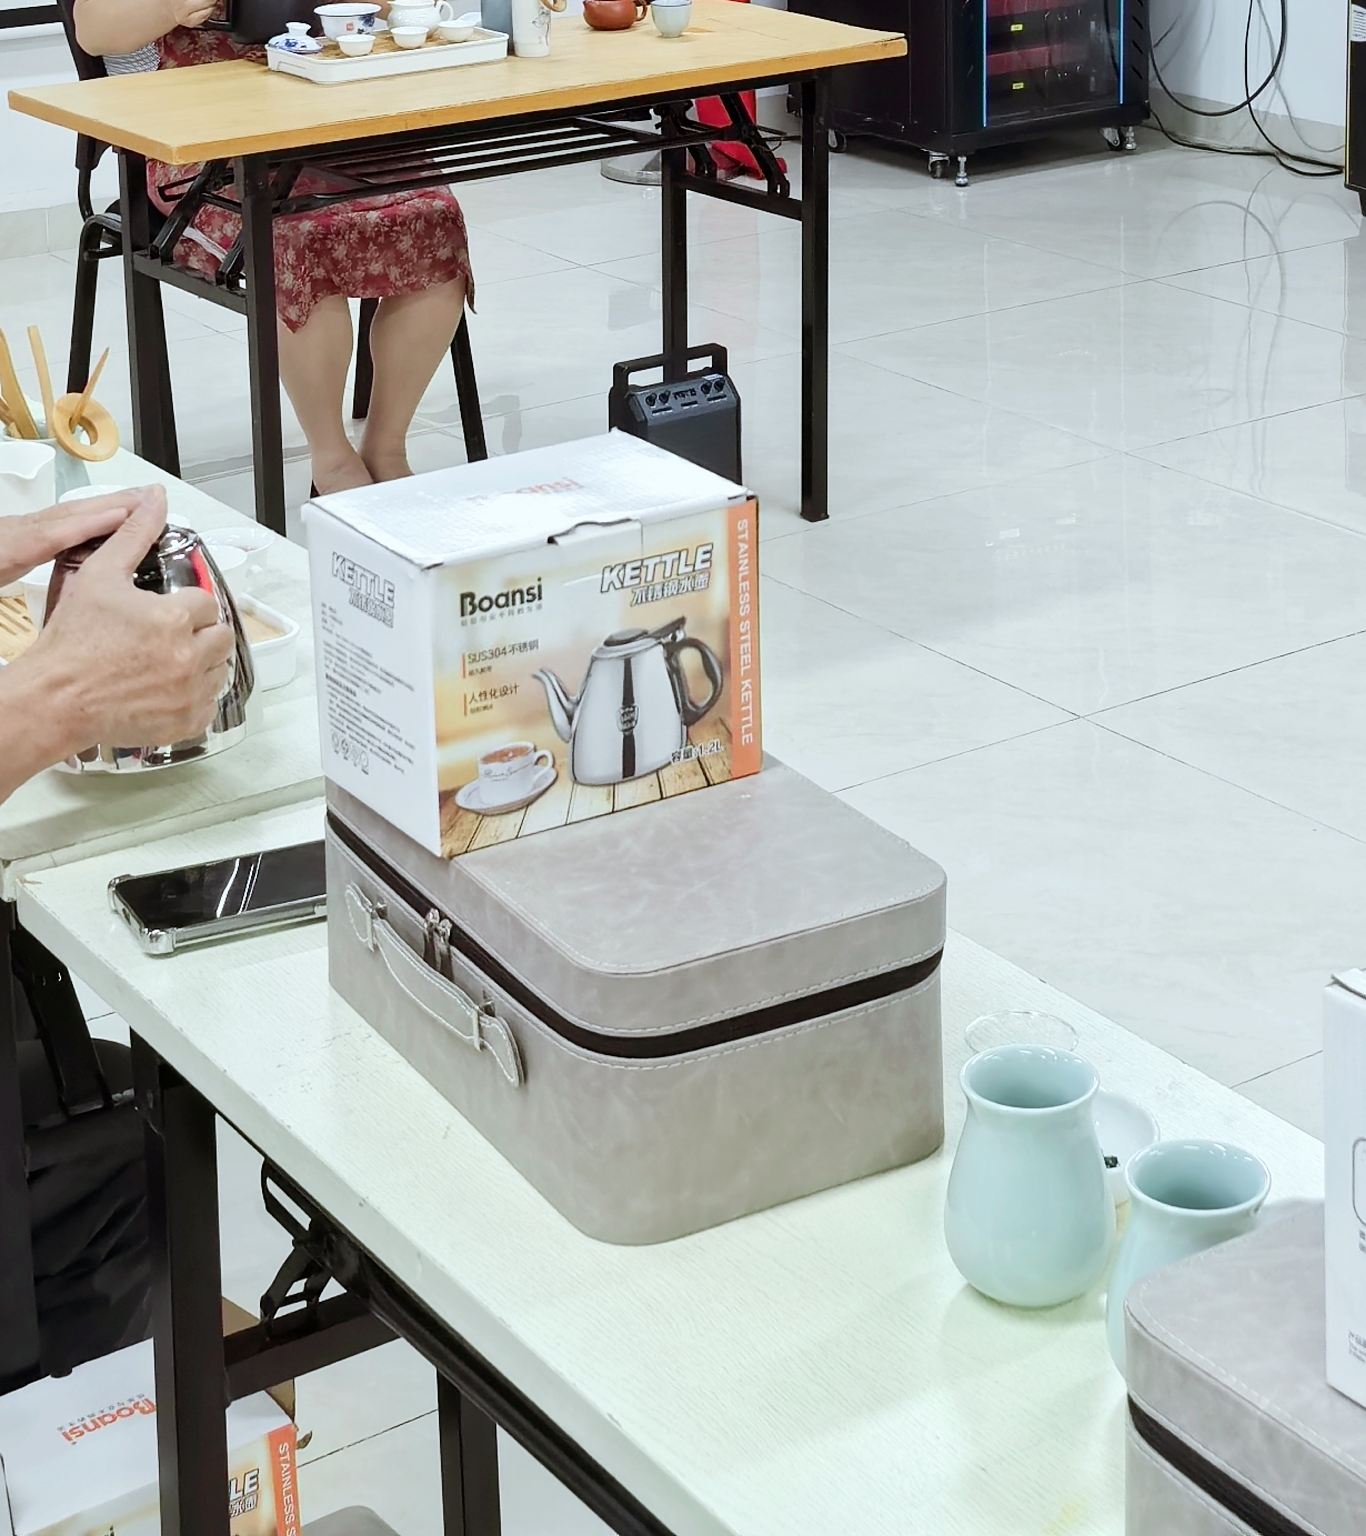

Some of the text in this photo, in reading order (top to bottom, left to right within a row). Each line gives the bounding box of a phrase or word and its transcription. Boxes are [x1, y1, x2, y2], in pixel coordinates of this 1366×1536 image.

[331, 551, 395, 609] KETTLE
[600, 543, 713, 593] KETTLE
[460, 577, 543, 617] Boansi
[737, 518, 753, 747] STAINLESS STEEL KETTLE
[468, 683, 520, 705] 人性化设计
[62, 1398, 156, 1445] Boansi
[278, 1442, 295, 1525] STAINLESS
